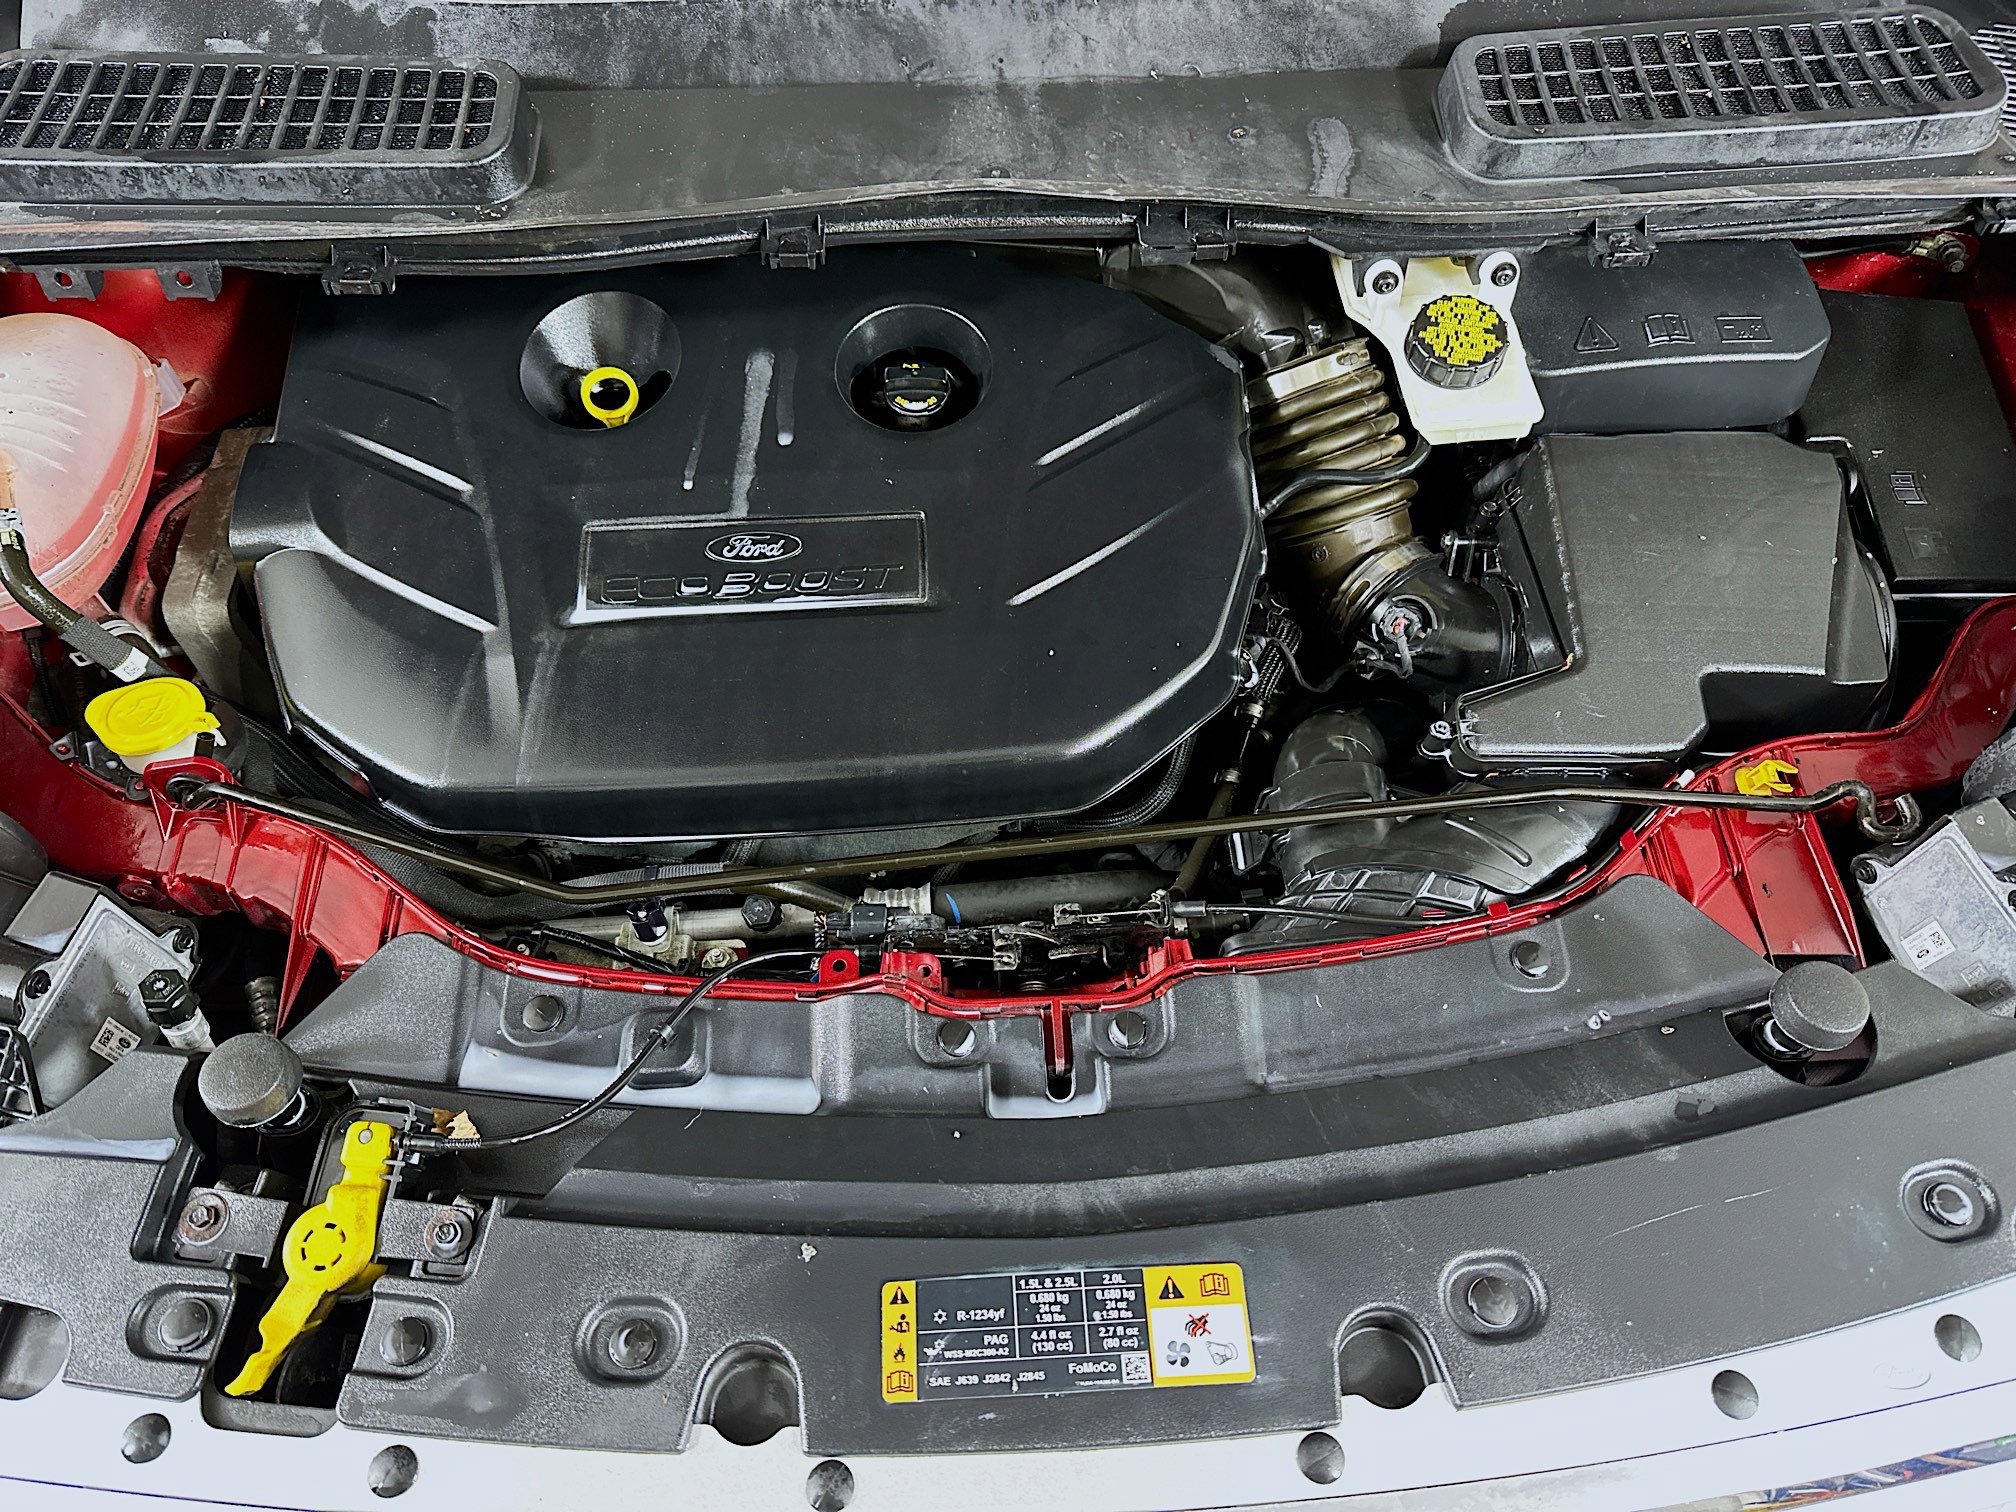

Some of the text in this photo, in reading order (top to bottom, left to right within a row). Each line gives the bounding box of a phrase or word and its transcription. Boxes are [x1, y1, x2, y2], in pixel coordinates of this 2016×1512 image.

[722, 534, 785, 558] Ford
[1019, 1276, 1079, 1290] 1.5L & 2.5L
[1102, 1273, 1127, 1285] 2.0L
[1029, 1291, 1070, 1305] 0.680 kg
[1095, 1288, 1136, 1301] 0.680 kg
[1039, 1303, 1061, 1313] 24 oz
[1105, 1300, 1128, 1310] 24 oz
[956, 1307, 1006, 1322] R-1234yf
[1035, 1312, 1067, 1323] 1.50 lbs
[1101, 1309, 1134, 1320] 1.50 lbs
[1030, 1329, 1072, 1341] 4.4 fl oz
[1098, 1325, 1140, 1338] 2.7 fl oz
[983, 1333, 1009, 1346] PAG
[1121, 1336, 1139, 1349] cc)
[1031, 1339, 1074, 1355] (130 cc)
[1068, 1361, 1118, 1375] FoMoCo
[928, 1371, 1046, 1387] SAE J639 J2842 J2845
